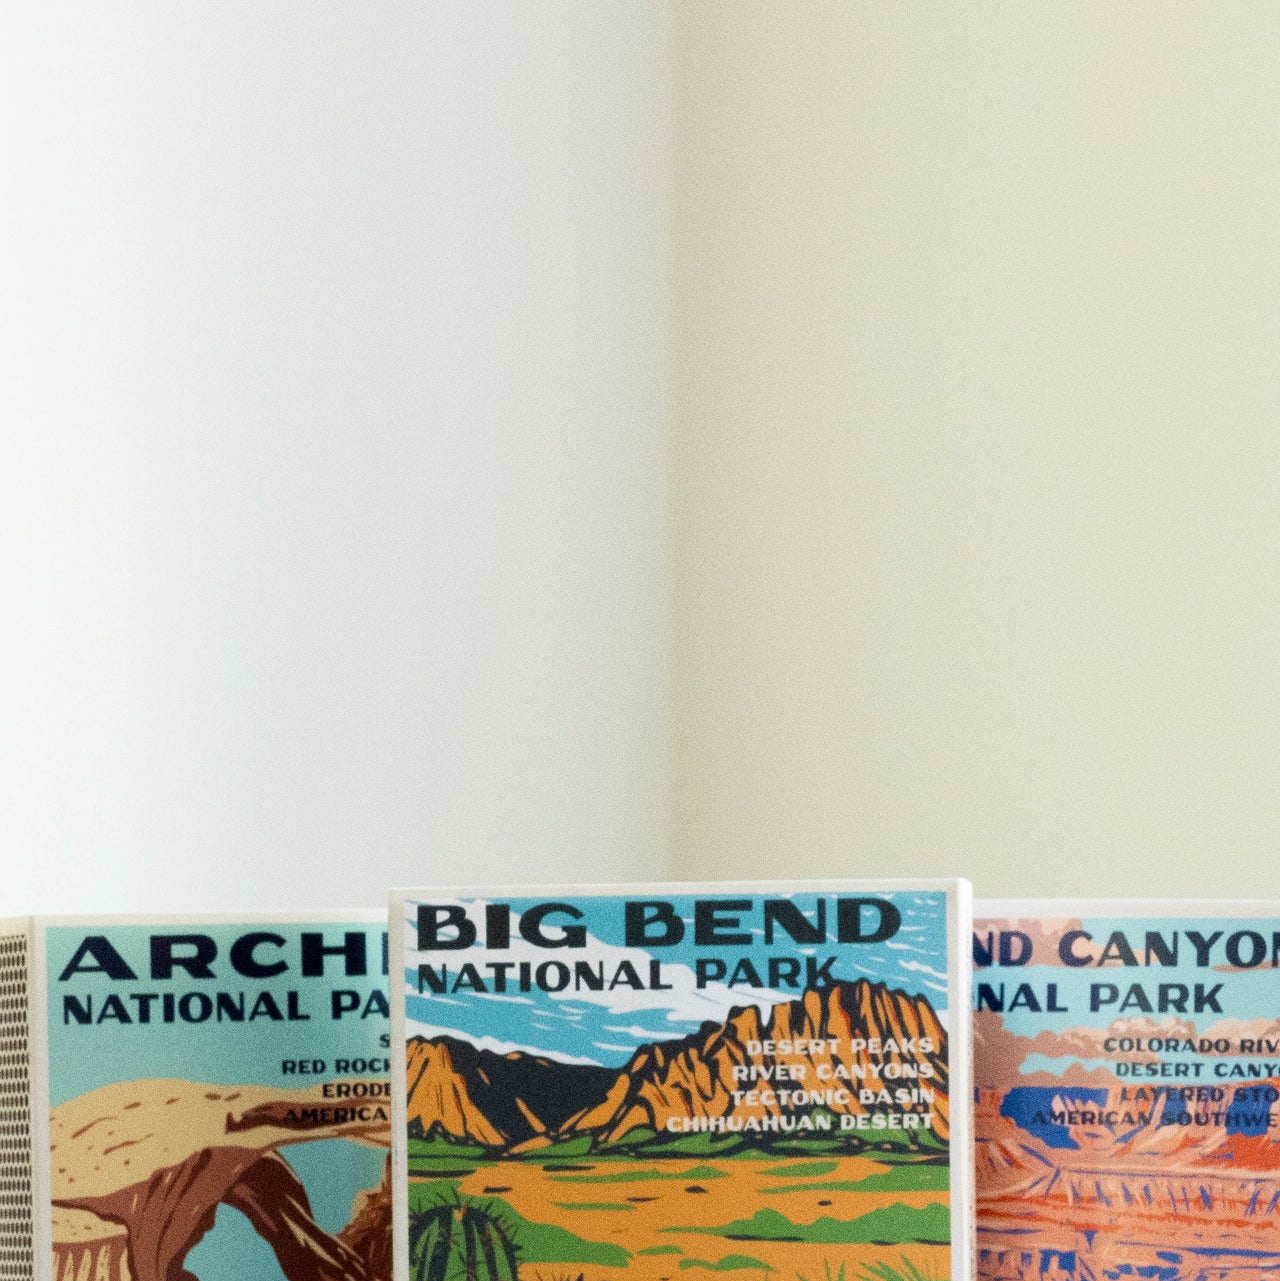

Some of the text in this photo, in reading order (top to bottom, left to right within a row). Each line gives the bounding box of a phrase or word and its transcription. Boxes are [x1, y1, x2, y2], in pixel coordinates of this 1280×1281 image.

[417, 898, 902, 950] BIG BEND
[58, 932, 389, 981] ARCH
[417, 956, 838, 994] NATIONAL PARK
[64, 991, 310, 1025] NATIONAL
[1090, 984, 1223, 1013] PARK
[747, 1037, 934, 1057] DESERT PEAKS
[1104, 1038, 1230, 1054] COLORADO
[282, 1060, 325, 1075] RED
[732, 1062, 935, 1081] RIVER CANYONS
[1116, 1062, 1201, 1078] DESERT
[730, 1087, 935, 1107] TECTONIC BASIN
[667, 1112, 935, 1132] CHIHUAHUAN DESERT
[1031, 1110, 1151, 1127] AMERICAN
